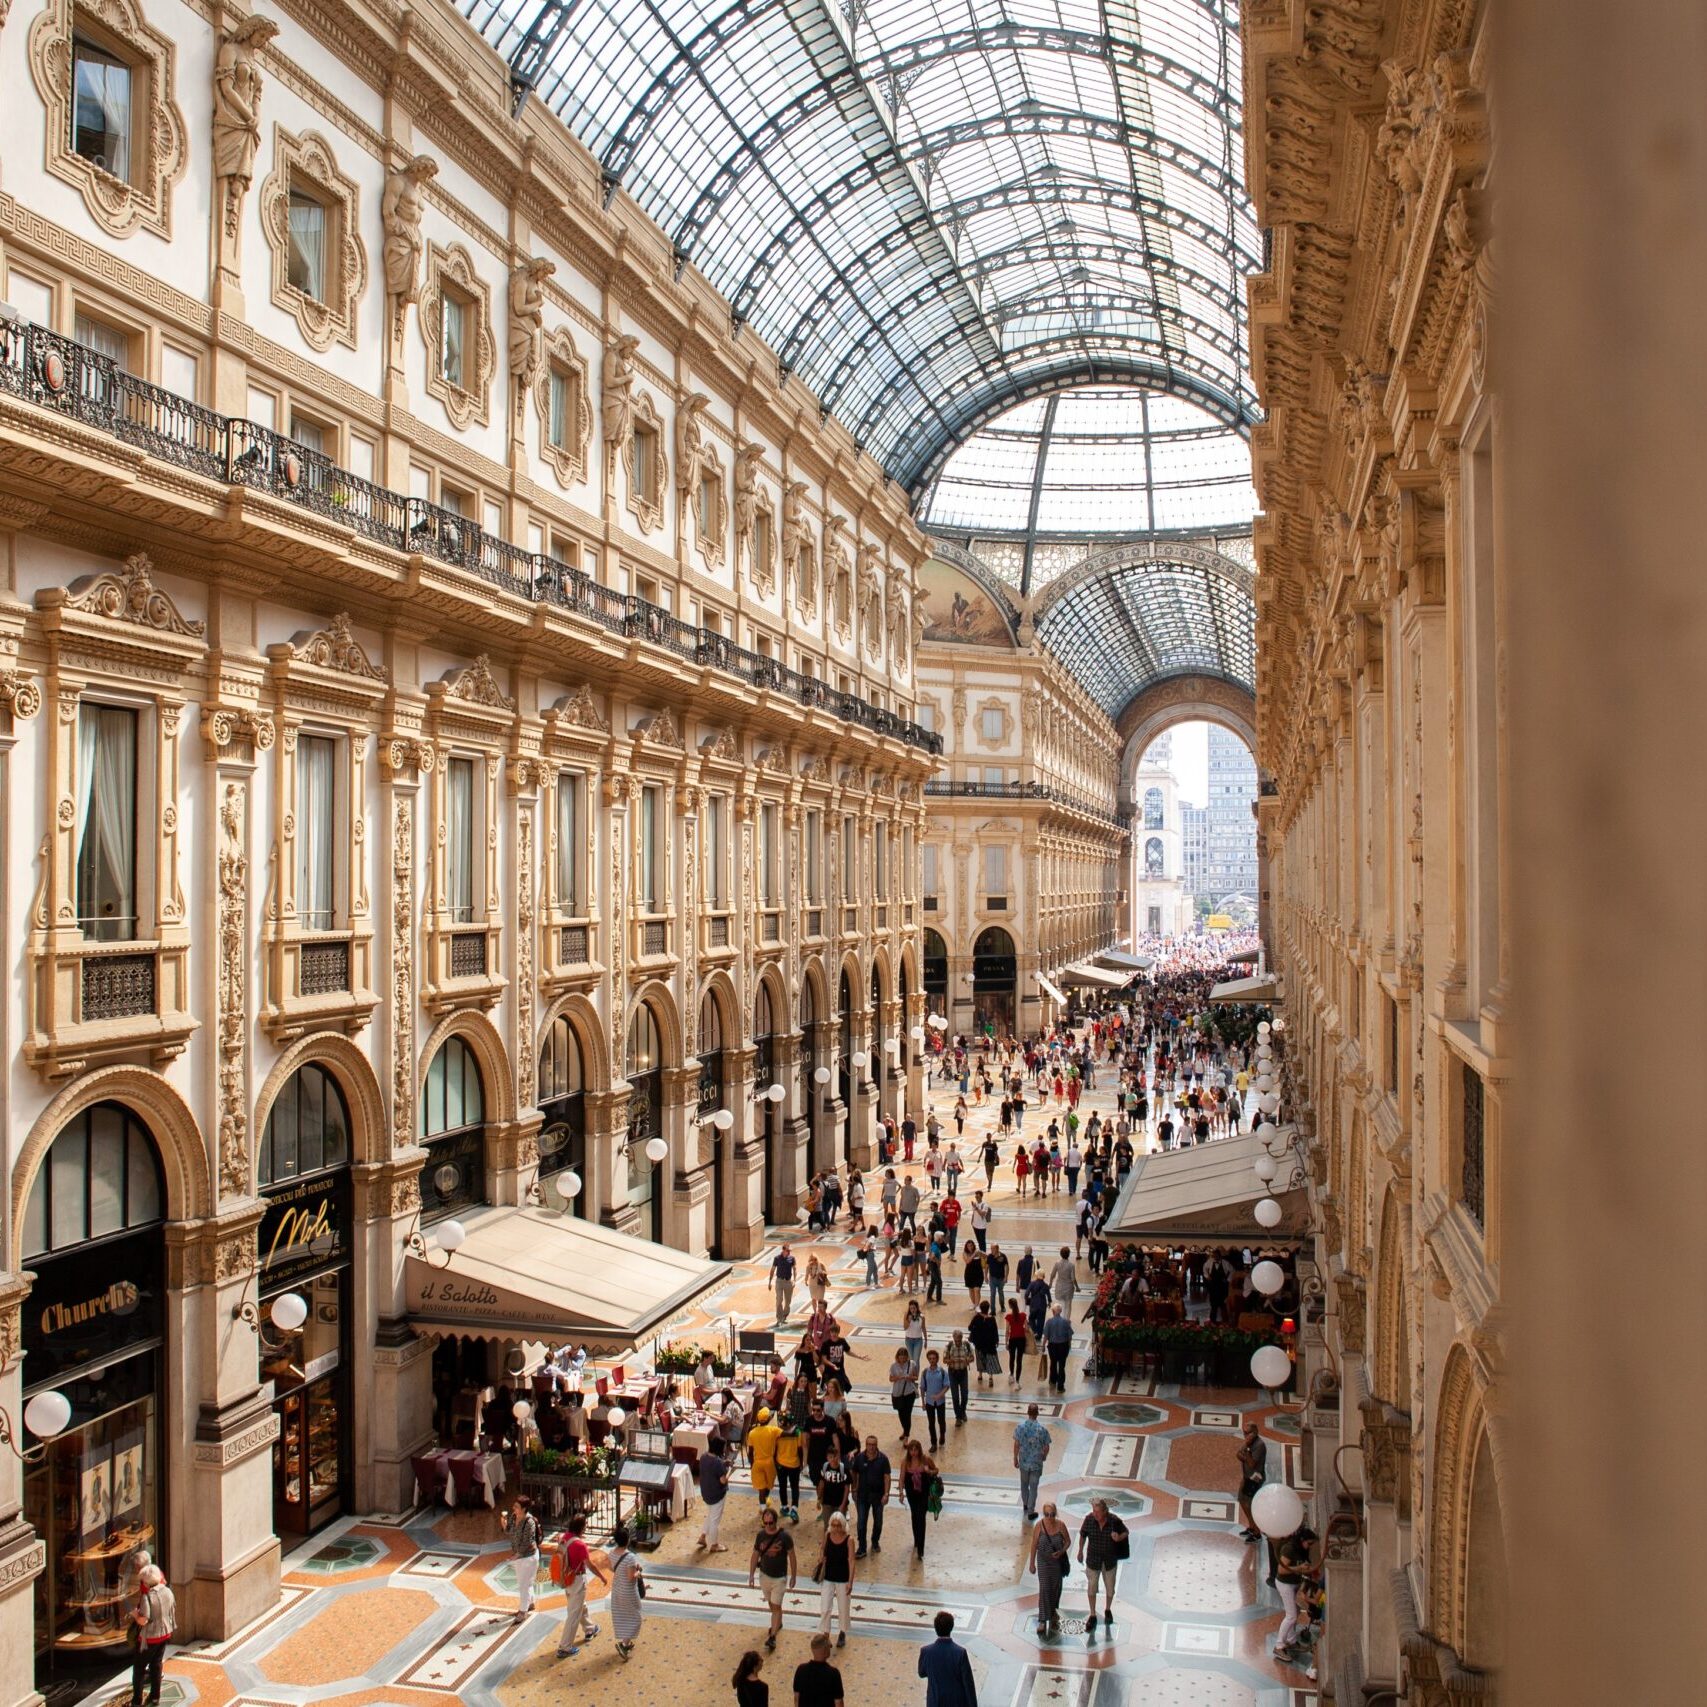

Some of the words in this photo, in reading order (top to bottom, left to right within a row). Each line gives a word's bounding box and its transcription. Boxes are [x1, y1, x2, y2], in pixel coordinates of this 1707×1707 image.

[42, 1280, 138, 1334] Church's
[421, 1282, 434, 1299] il
[439, 1283, 498, 1305] Salotto
